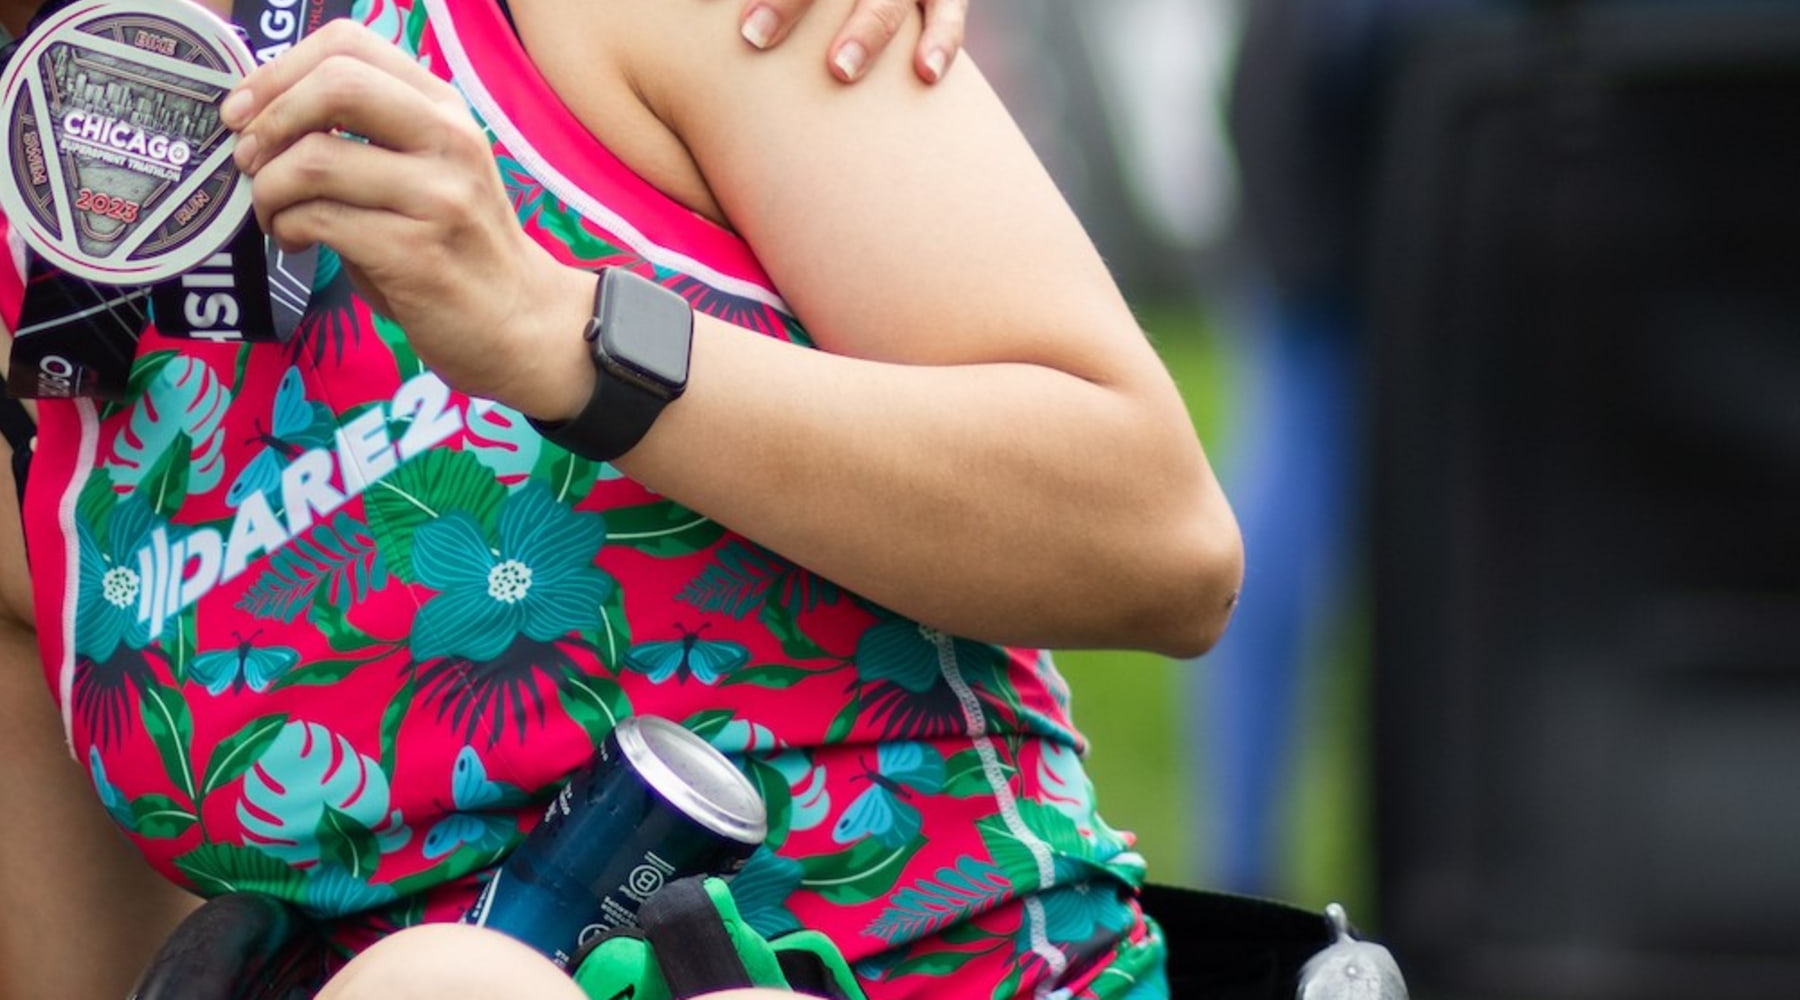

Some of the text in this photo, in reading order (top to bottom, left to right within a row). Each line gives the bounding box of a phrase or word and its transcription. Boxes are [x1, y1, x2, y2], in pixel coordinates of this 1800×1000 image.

[135, 30, 177, 56] BIKE
[63, 109, 191, 166] CHICAGO
[22, 130, 48, 186] SWIM
[128, 156, 182, 182] TRIATHLON
[76, 187, 140, 224] 2023
[174, 190, 210, 226] RUN
